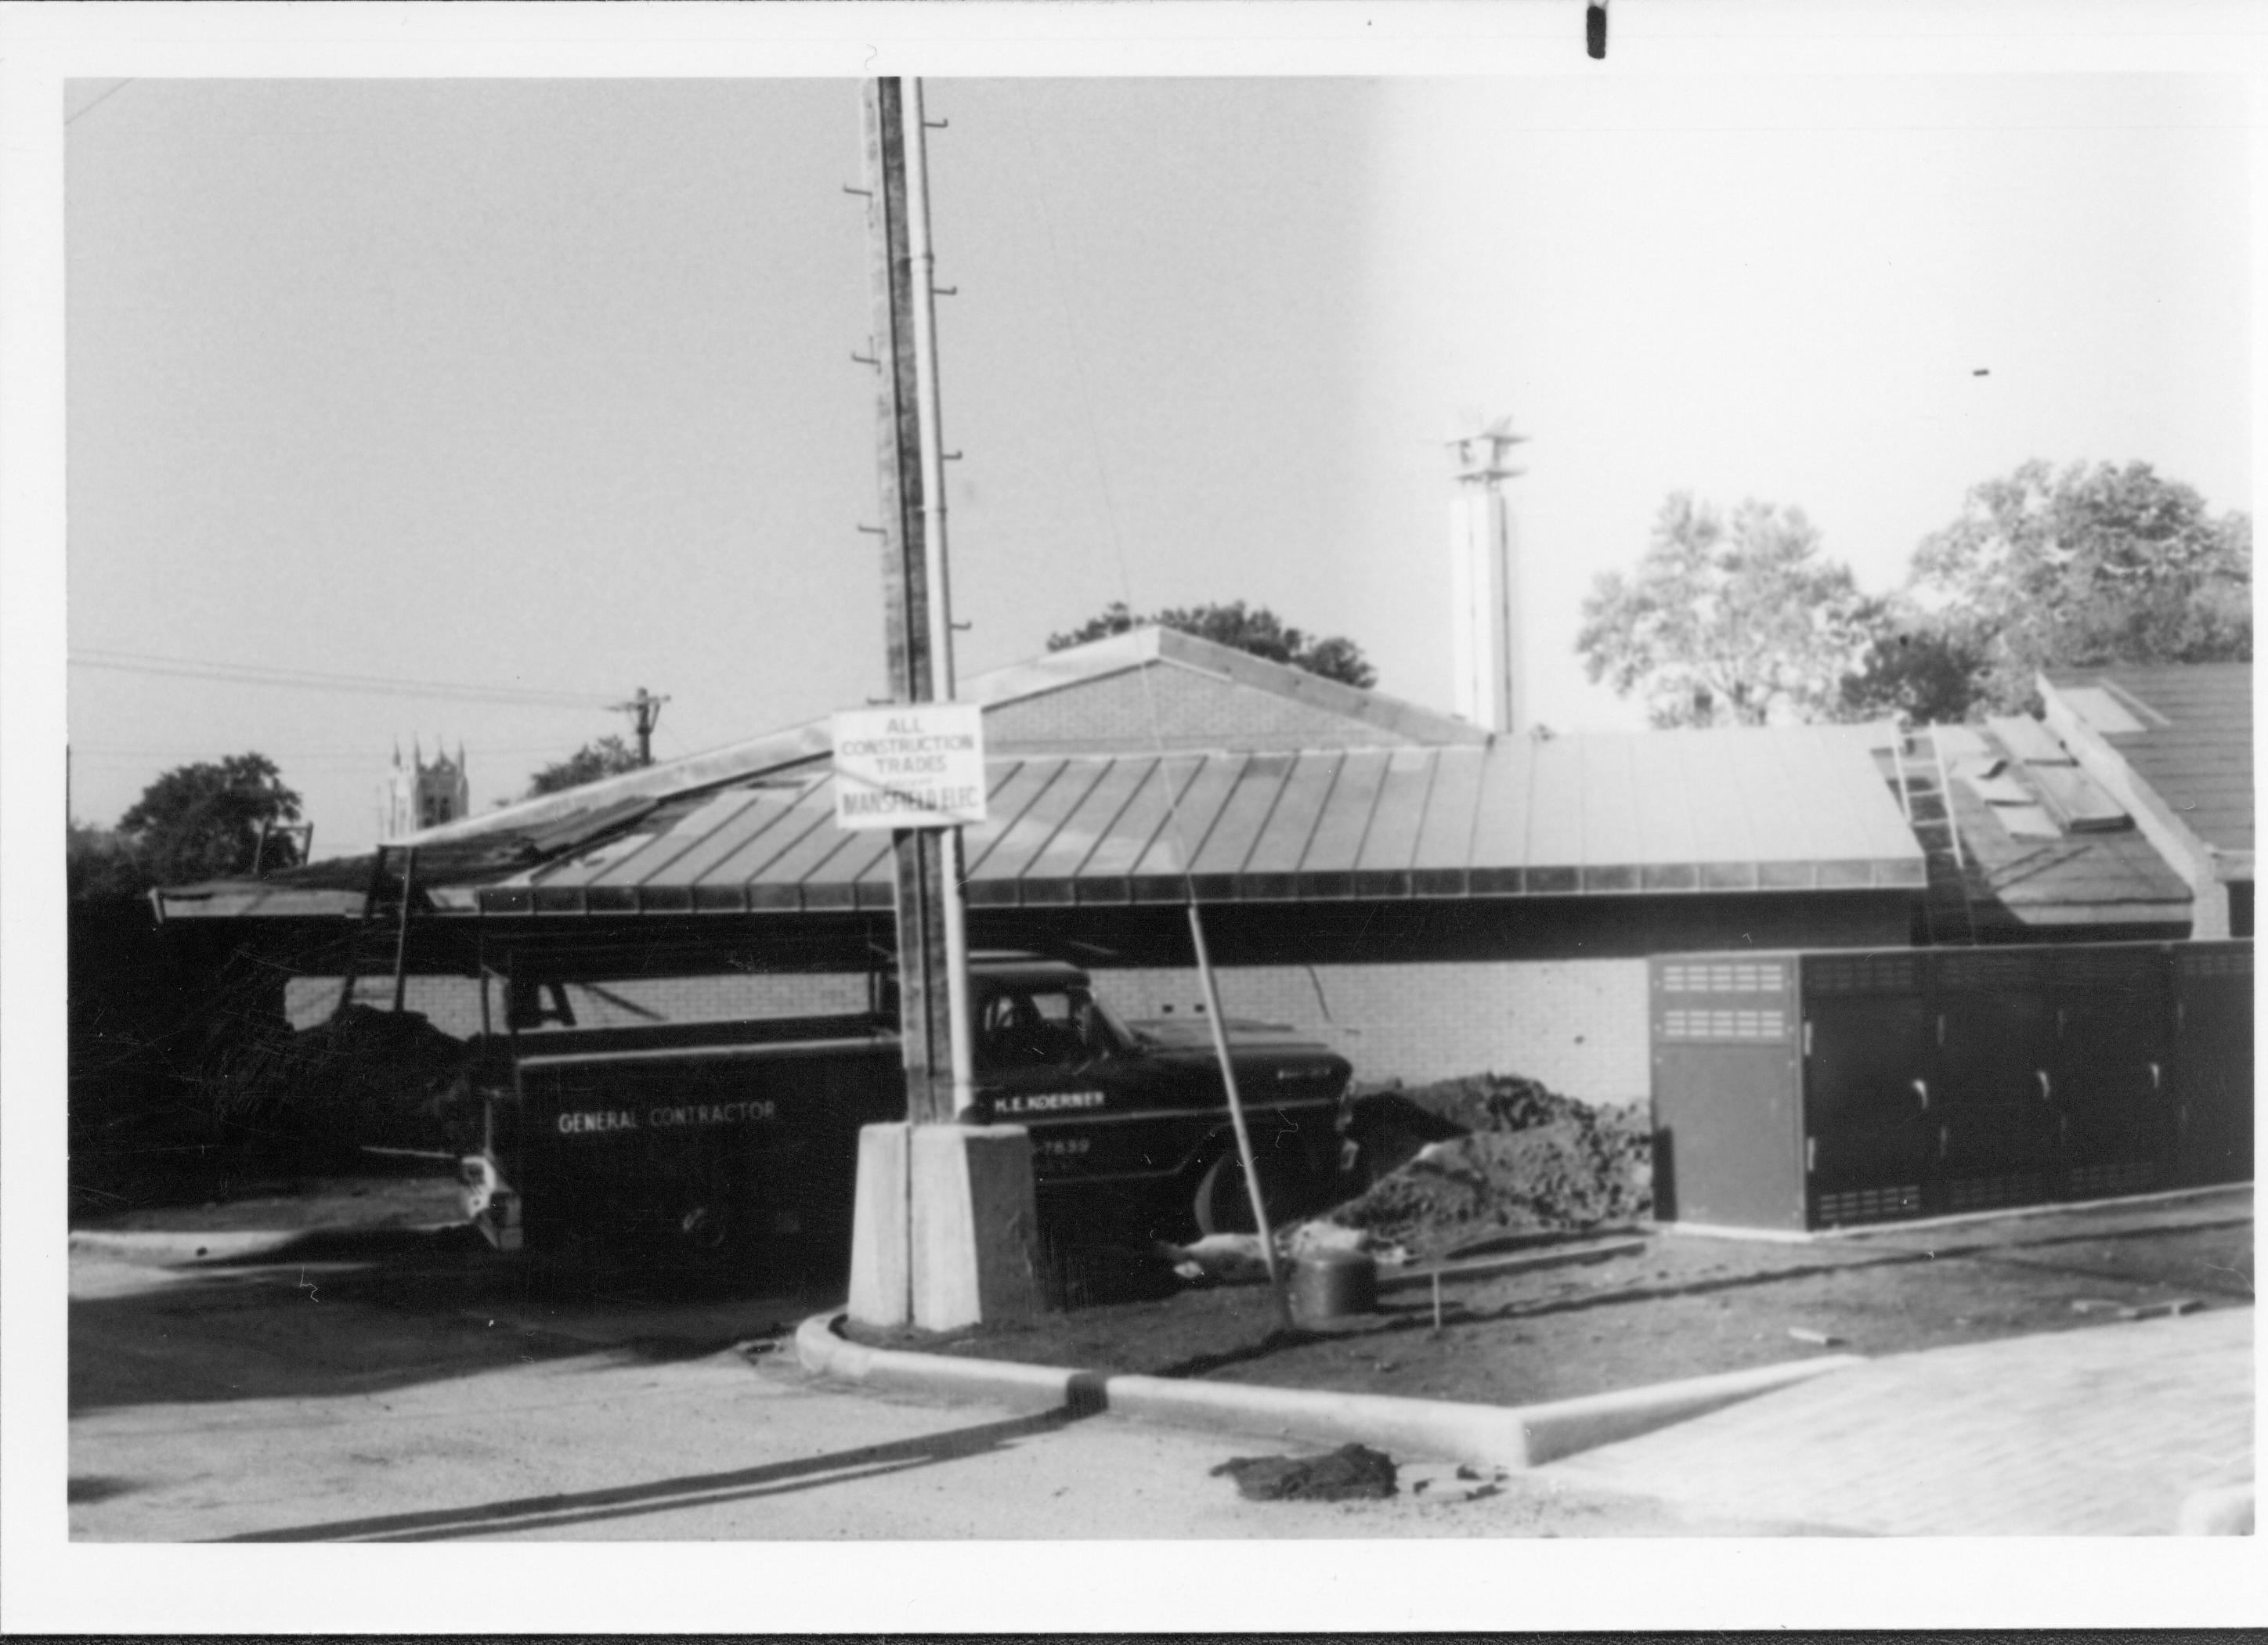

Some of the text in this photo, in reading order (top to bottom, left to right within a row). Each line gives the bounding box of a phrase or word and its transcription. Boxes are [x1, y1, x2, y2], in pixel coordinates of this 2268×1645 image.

[887, 717, 924, 734] ALL
[841, 734, 973, 756] CONSTRUCTION
[876, 755, 948, 774] TRADES
[558, 1100, 775, 1133] GENERAL CONTRACTOR
